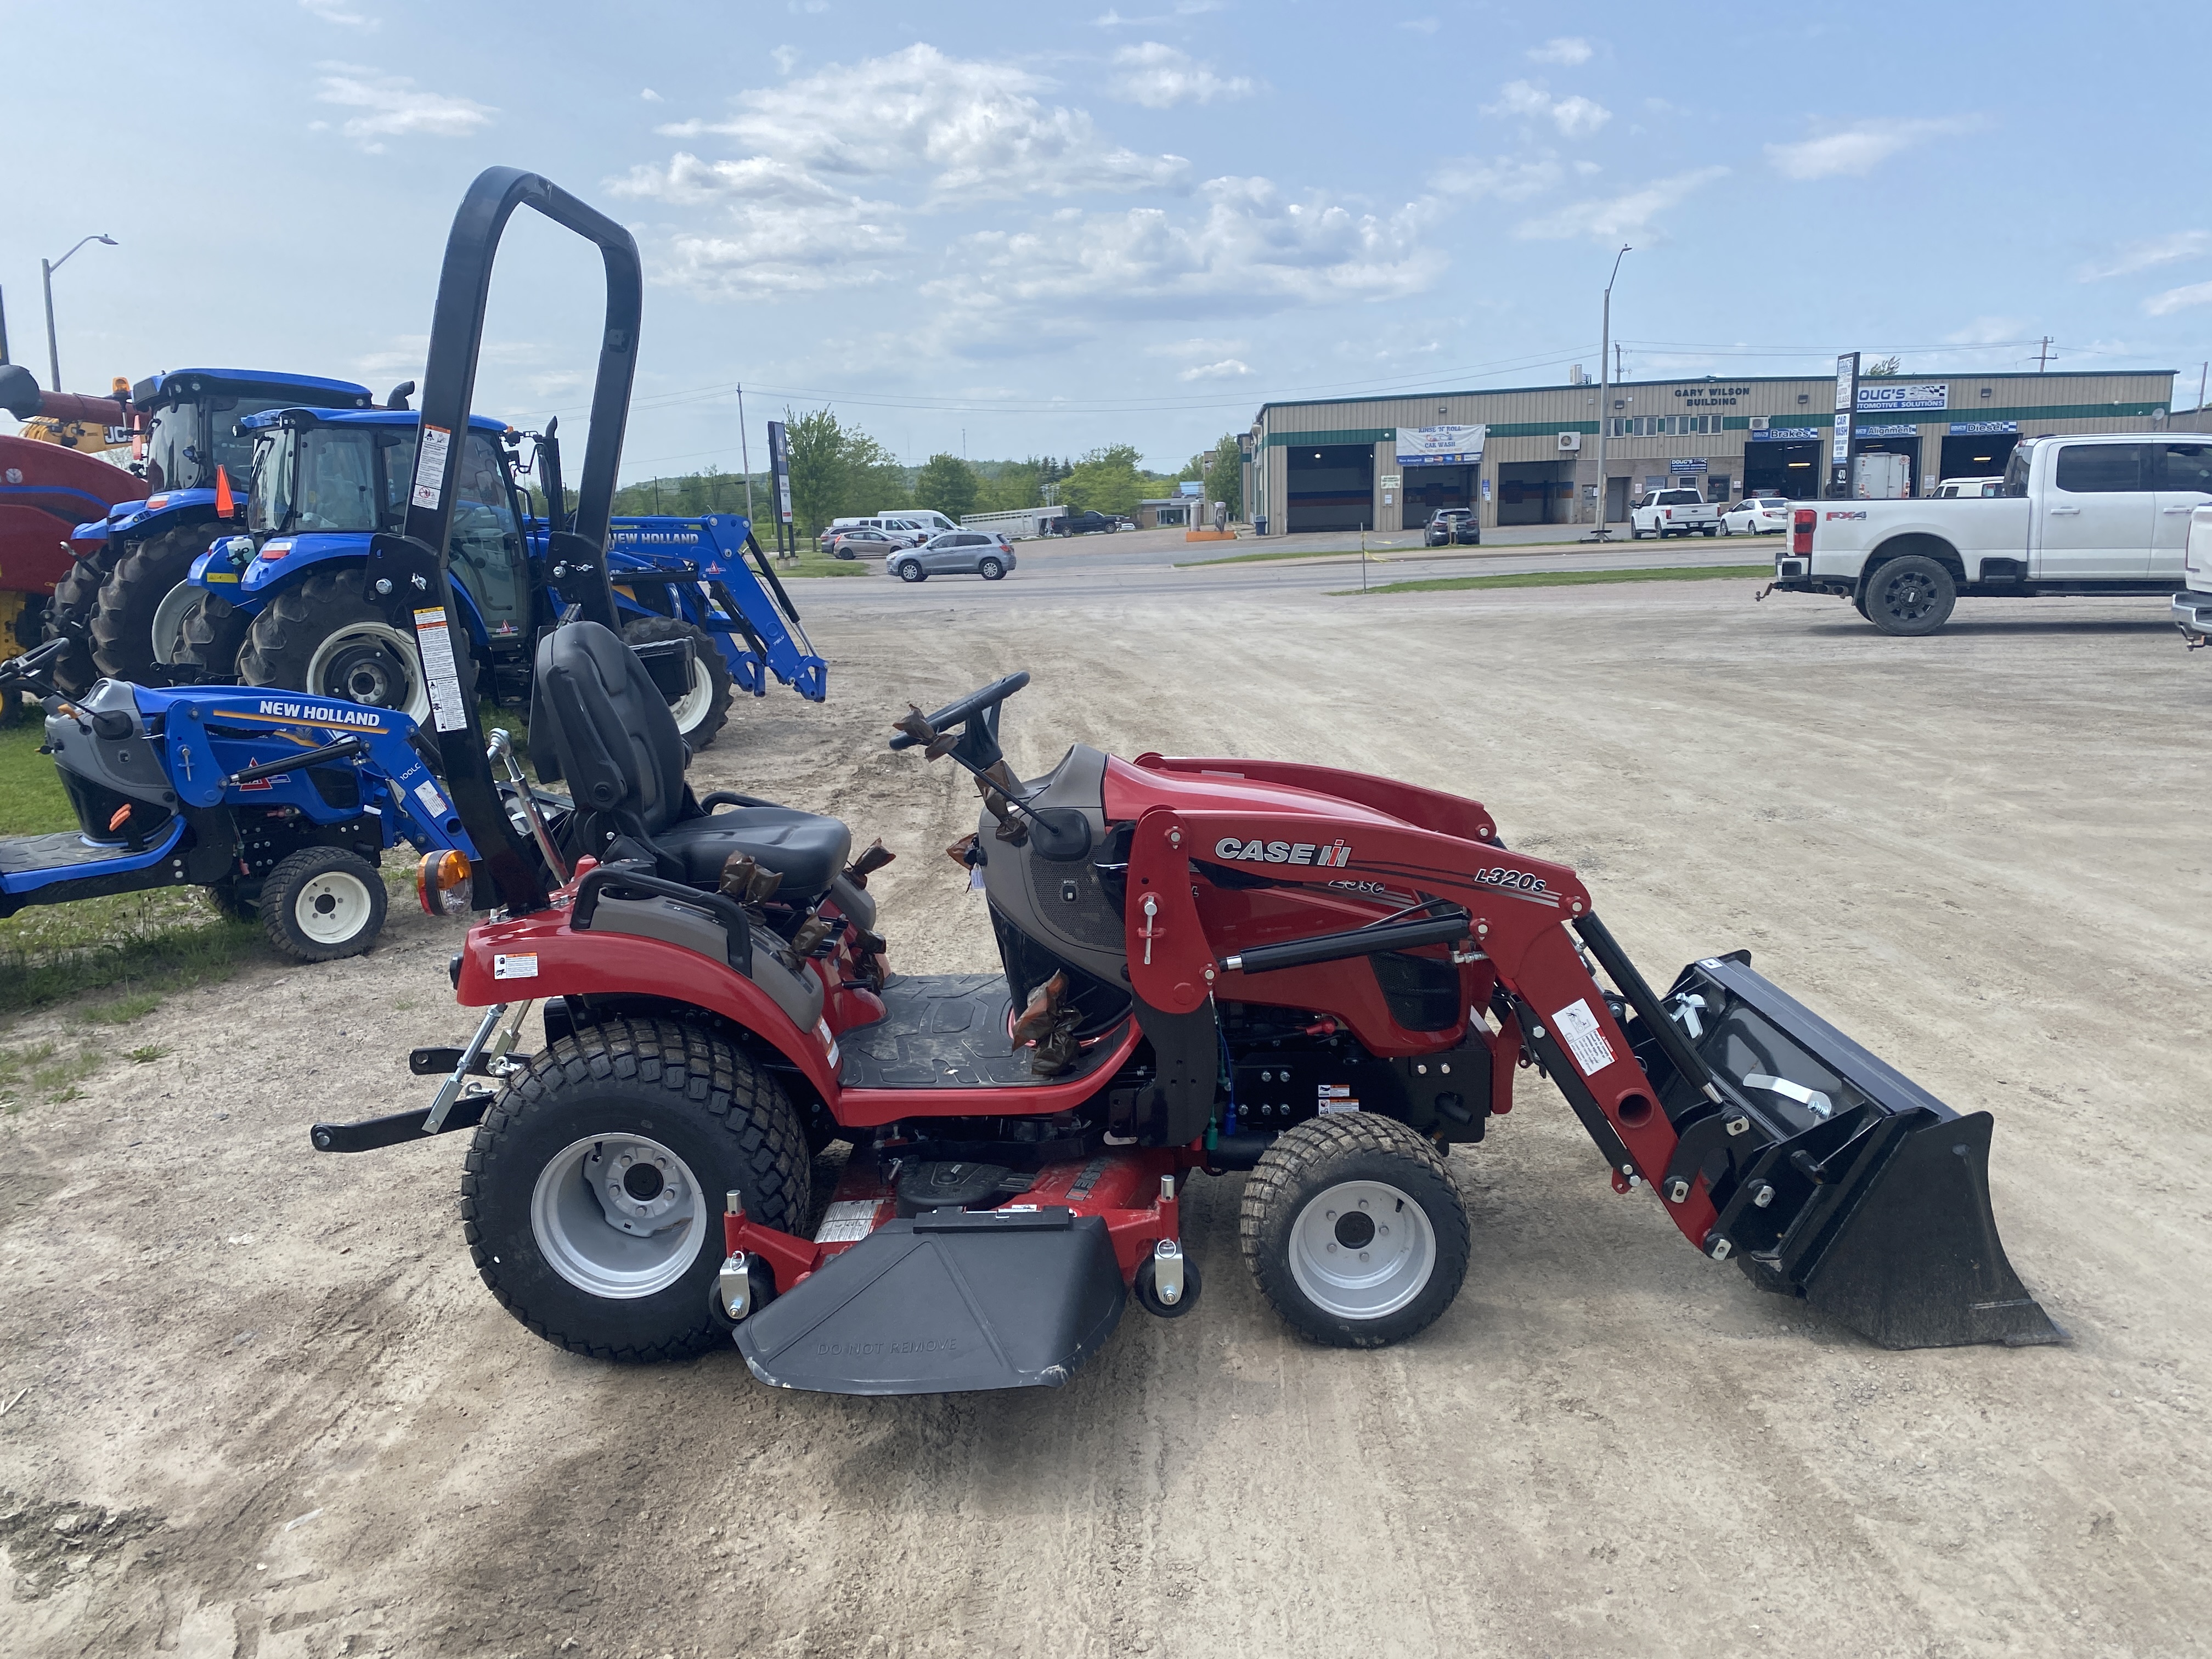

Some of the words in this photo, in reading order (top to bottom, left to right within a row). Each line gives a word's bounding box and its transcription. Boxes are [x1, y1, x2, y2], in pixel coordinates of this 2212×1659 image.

[1675, 388, 1703, 397] GARY
[1859, 389, 1906, 400] OUG'S
[1686, 398, 1736, 407] BUILDING
[1837, 415, 1846, 425] CAR
[1836, 426, 1848, 436] WASH
[1867, 426, 1912, 436] Alignment
[1968, 422, 2003, 432] Diesel
[105, 426, 133, 443] JC
[1771, 430, 1809, 438] Brakes
[1826, 511, 1867, 521] FX4
[641, 533, 699, 544] HOLLAND
[259, 701, 301, 718] NEW
[303, 705, 380, 727] HOLLAND
[1215, 837, 1316, 865] CASE
[817, 1344, 843, 1355] DO
[849, 1342, 884, 1355] NOT
[889, 1339, 957, 1354] REMOVE
